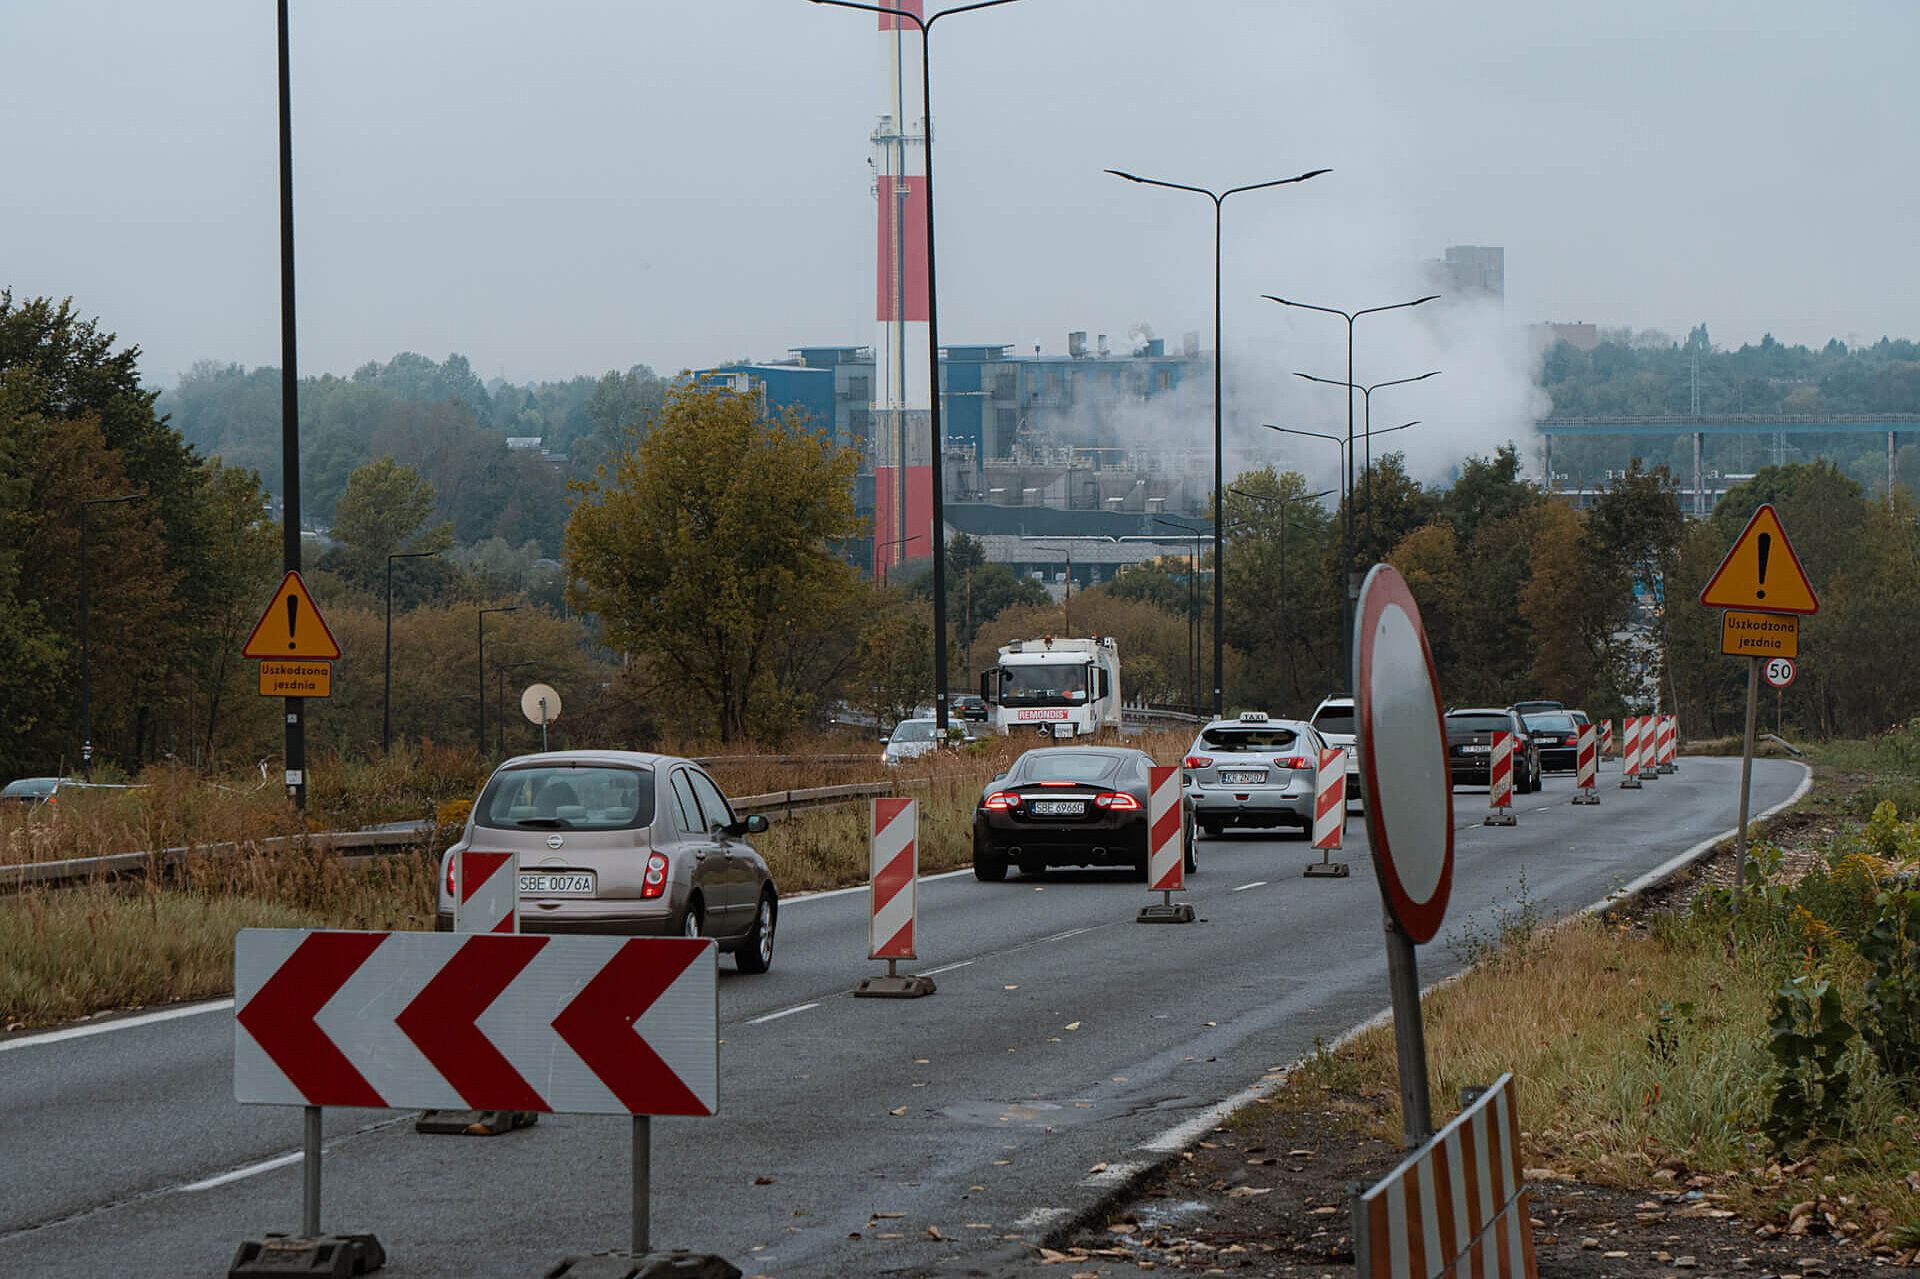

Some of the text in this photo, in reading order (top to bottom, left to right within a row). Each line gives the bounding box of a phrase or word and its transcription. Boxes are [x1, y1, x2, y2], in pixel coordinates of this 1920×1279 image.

[1728, 617, 1795, 632] Uszkodzona
[1738, 635, 1781, 648] jezdnia
[262, 664, 329, 676] Uszkodzona
[1769, 663, 1791, 679] 50
[273, 679, 316, 691] jezdnia
[1018, 710, 1063, 720] REMONDIS
[1036, 803, 1054, 813] SBE
[520, 877, 590, 891] SBE 0076A
